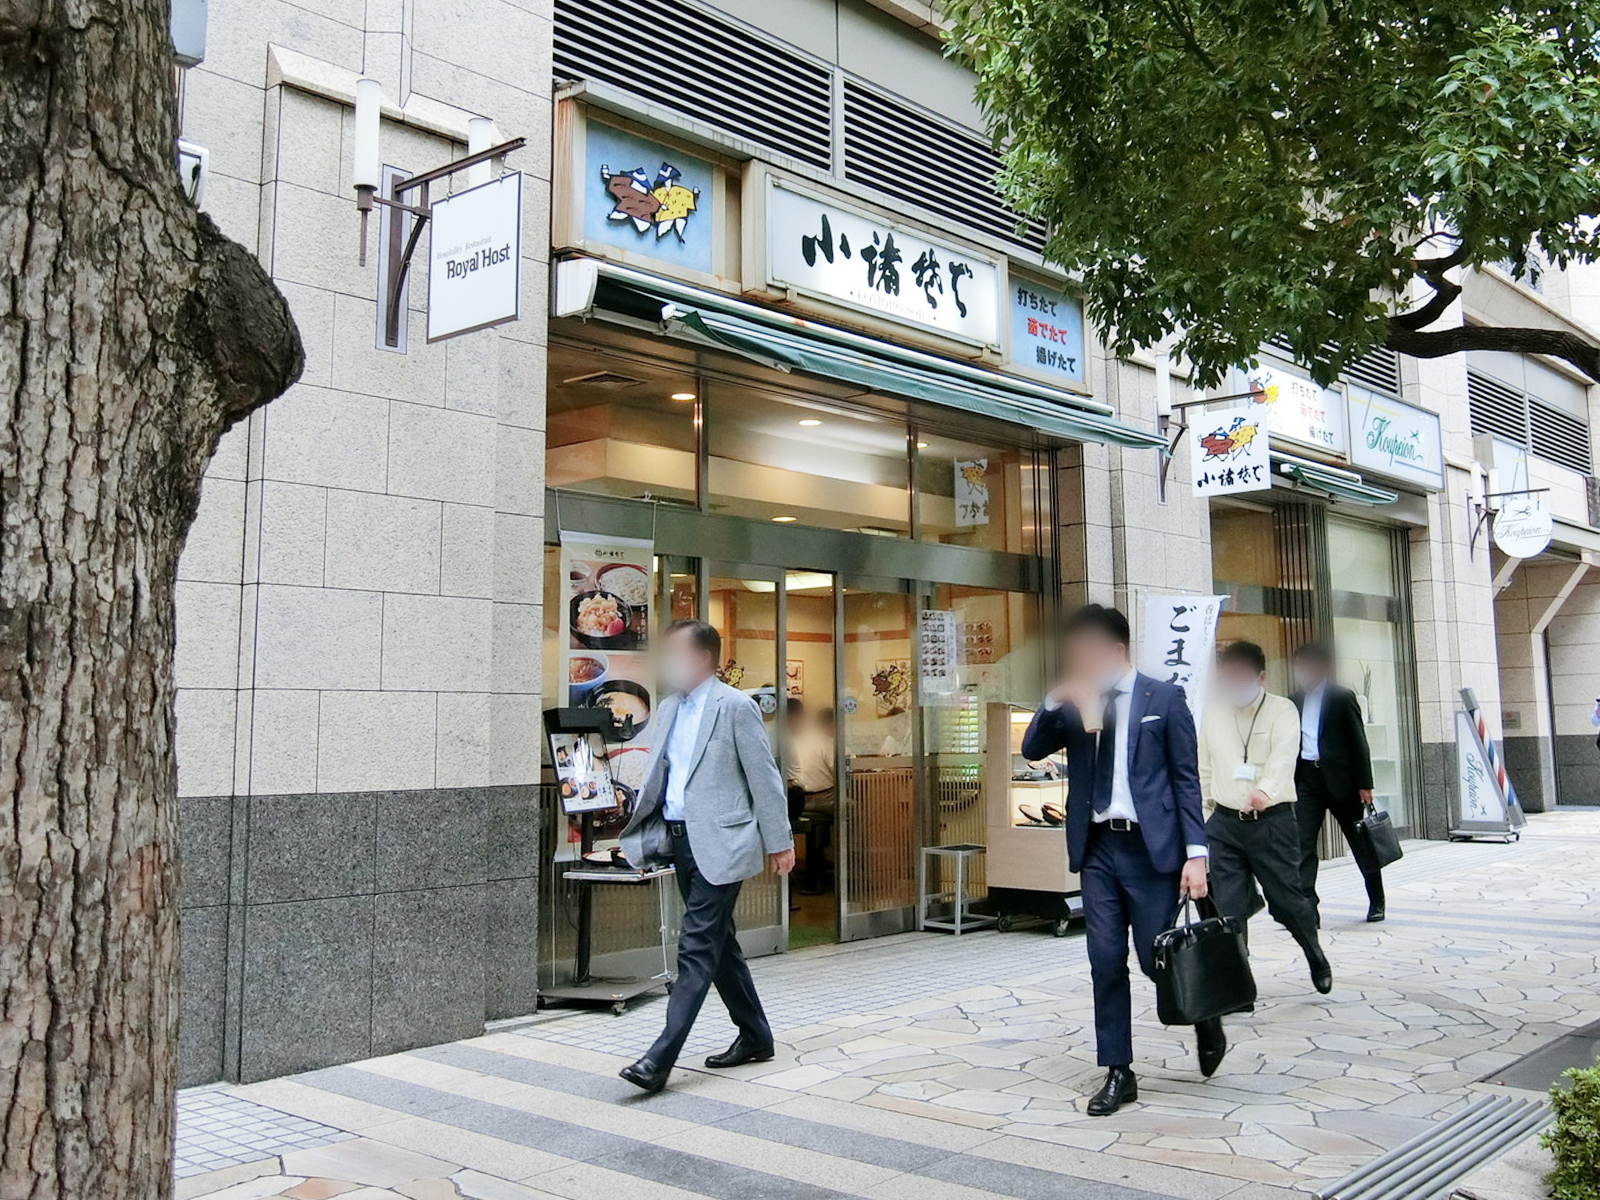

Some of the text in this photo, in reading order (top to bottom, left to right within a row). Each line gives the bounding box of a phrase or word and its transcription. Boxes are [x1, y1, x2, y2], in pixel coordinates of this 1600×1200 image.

[446, 242, 511, 279] Royal Host
[1017, 286, 1058, 317] 打ちたて
[1027, 316, 1068, 346] 茹でたて
[1036, 345, 1076, 373] 揚げたて
[1291, 381, 1318, 402] 打ちたて
